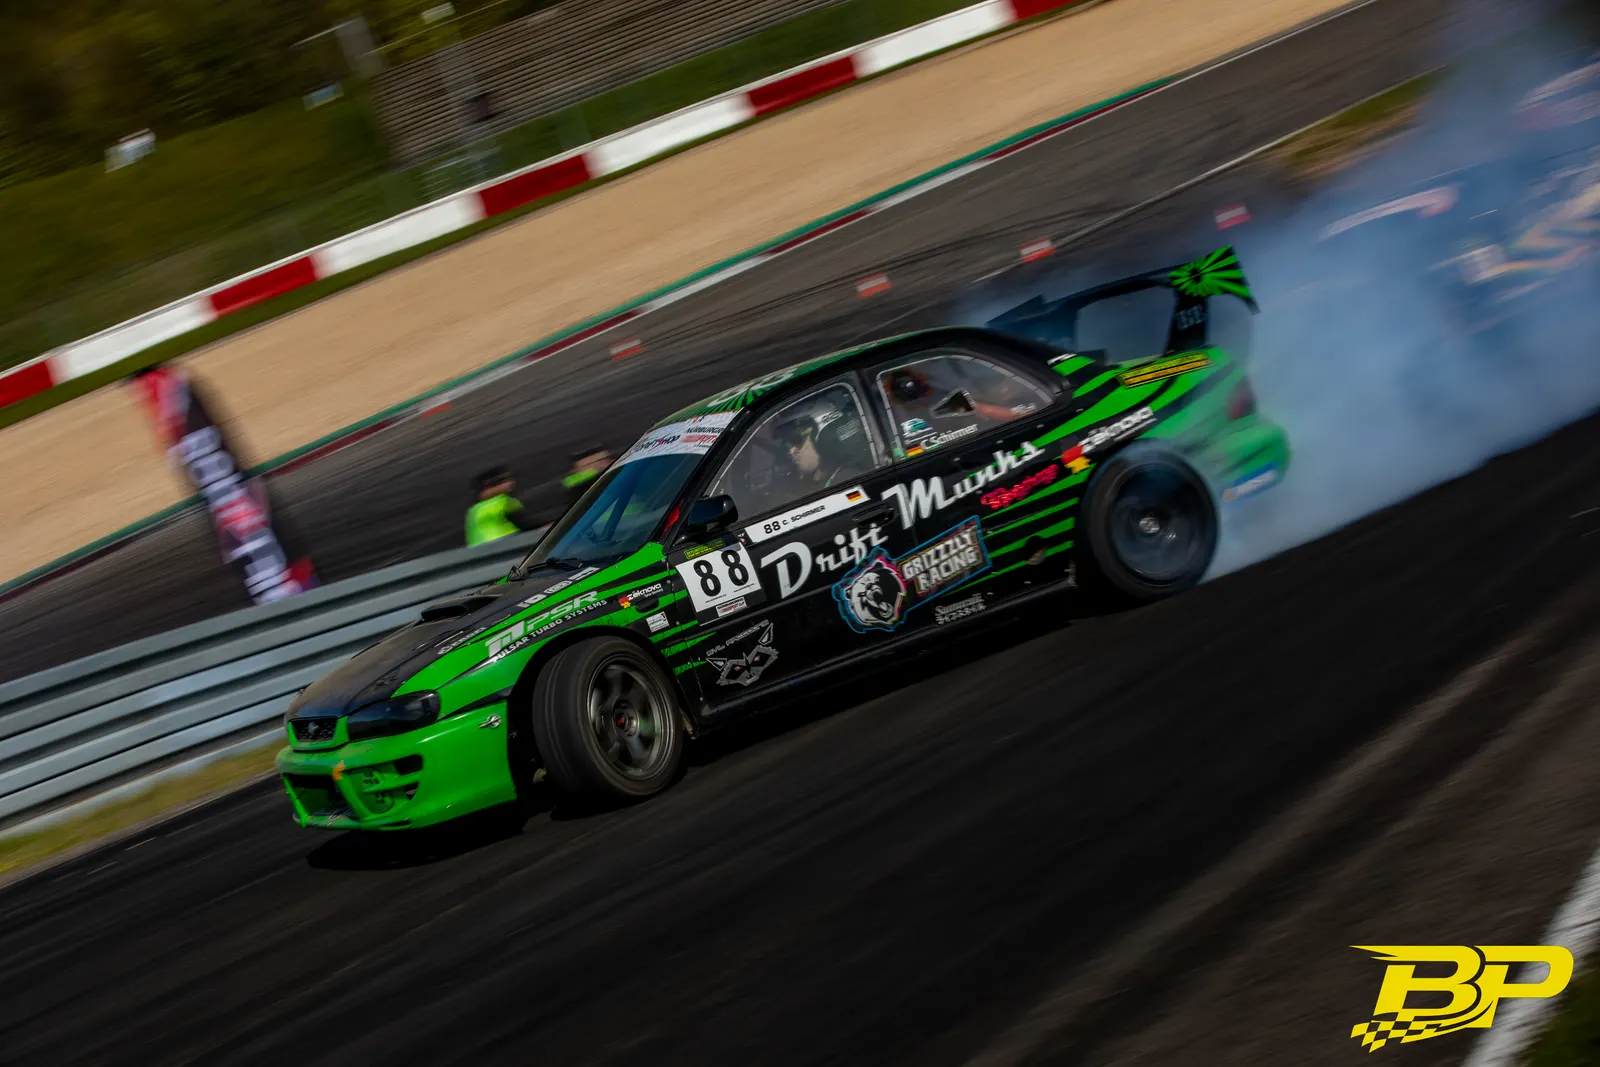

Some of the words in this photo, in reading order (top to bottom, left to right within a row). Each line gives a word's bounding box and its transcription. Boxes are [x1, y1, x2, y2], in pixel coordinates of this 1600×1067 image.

[761, 522, 888, 599] Drift
[881, 441, 1045, 530] Munks
[763, 521, 781, 535] 88
[791, 504, 826, 523] SCHIRMER
[693, 549, 749, 598] 88
[902, 525, 978, 580] GRIZZLY
[916, 548, 979, 592] RACING
[492, 636, 530, 664] PULSAR
[530, 617, 563, 639] TURBO
[563, 599, 608, 621] SYSTEMS
